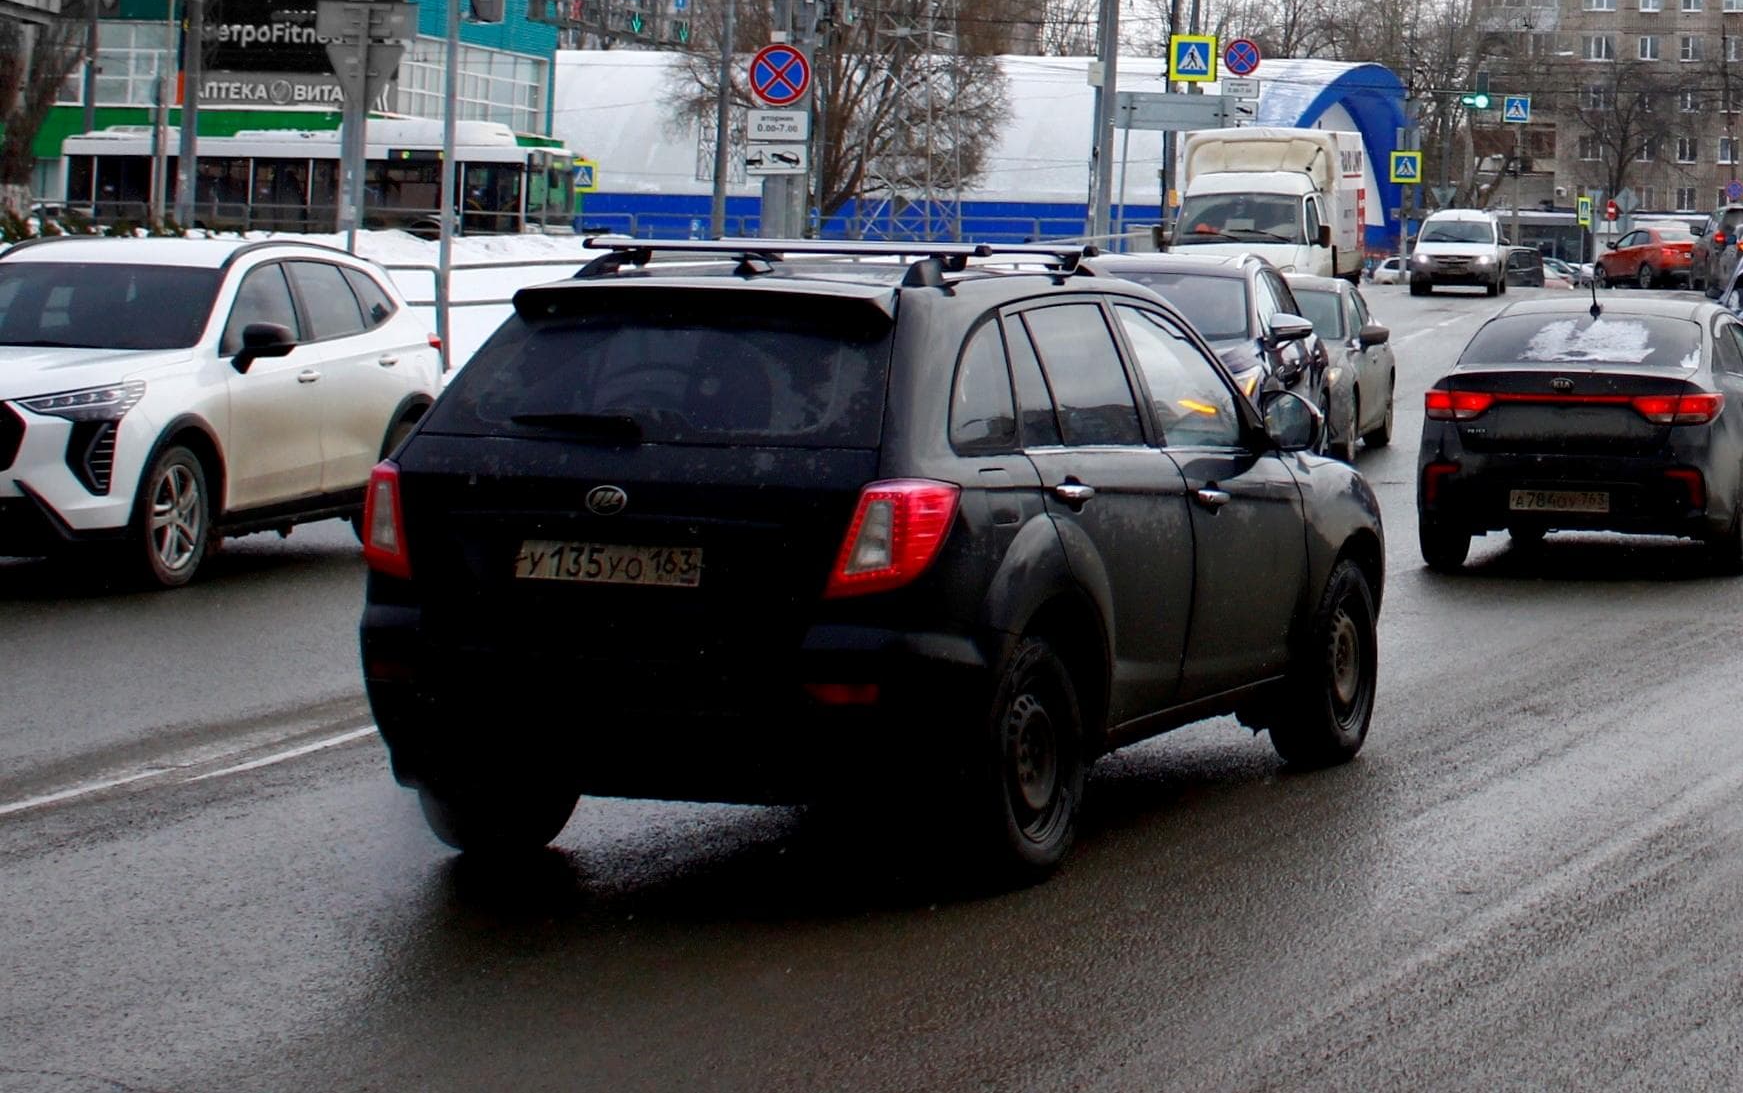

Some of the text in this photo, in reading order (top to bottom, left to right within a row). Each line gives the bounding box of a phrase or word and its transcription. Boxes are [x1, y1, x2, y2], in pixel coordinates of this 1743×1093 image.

[293, 84, 345, 102] ВИТА
[757, 123, 798, 133] 0.00-7.00
[528, 545, 693, 580] У135УО 163
